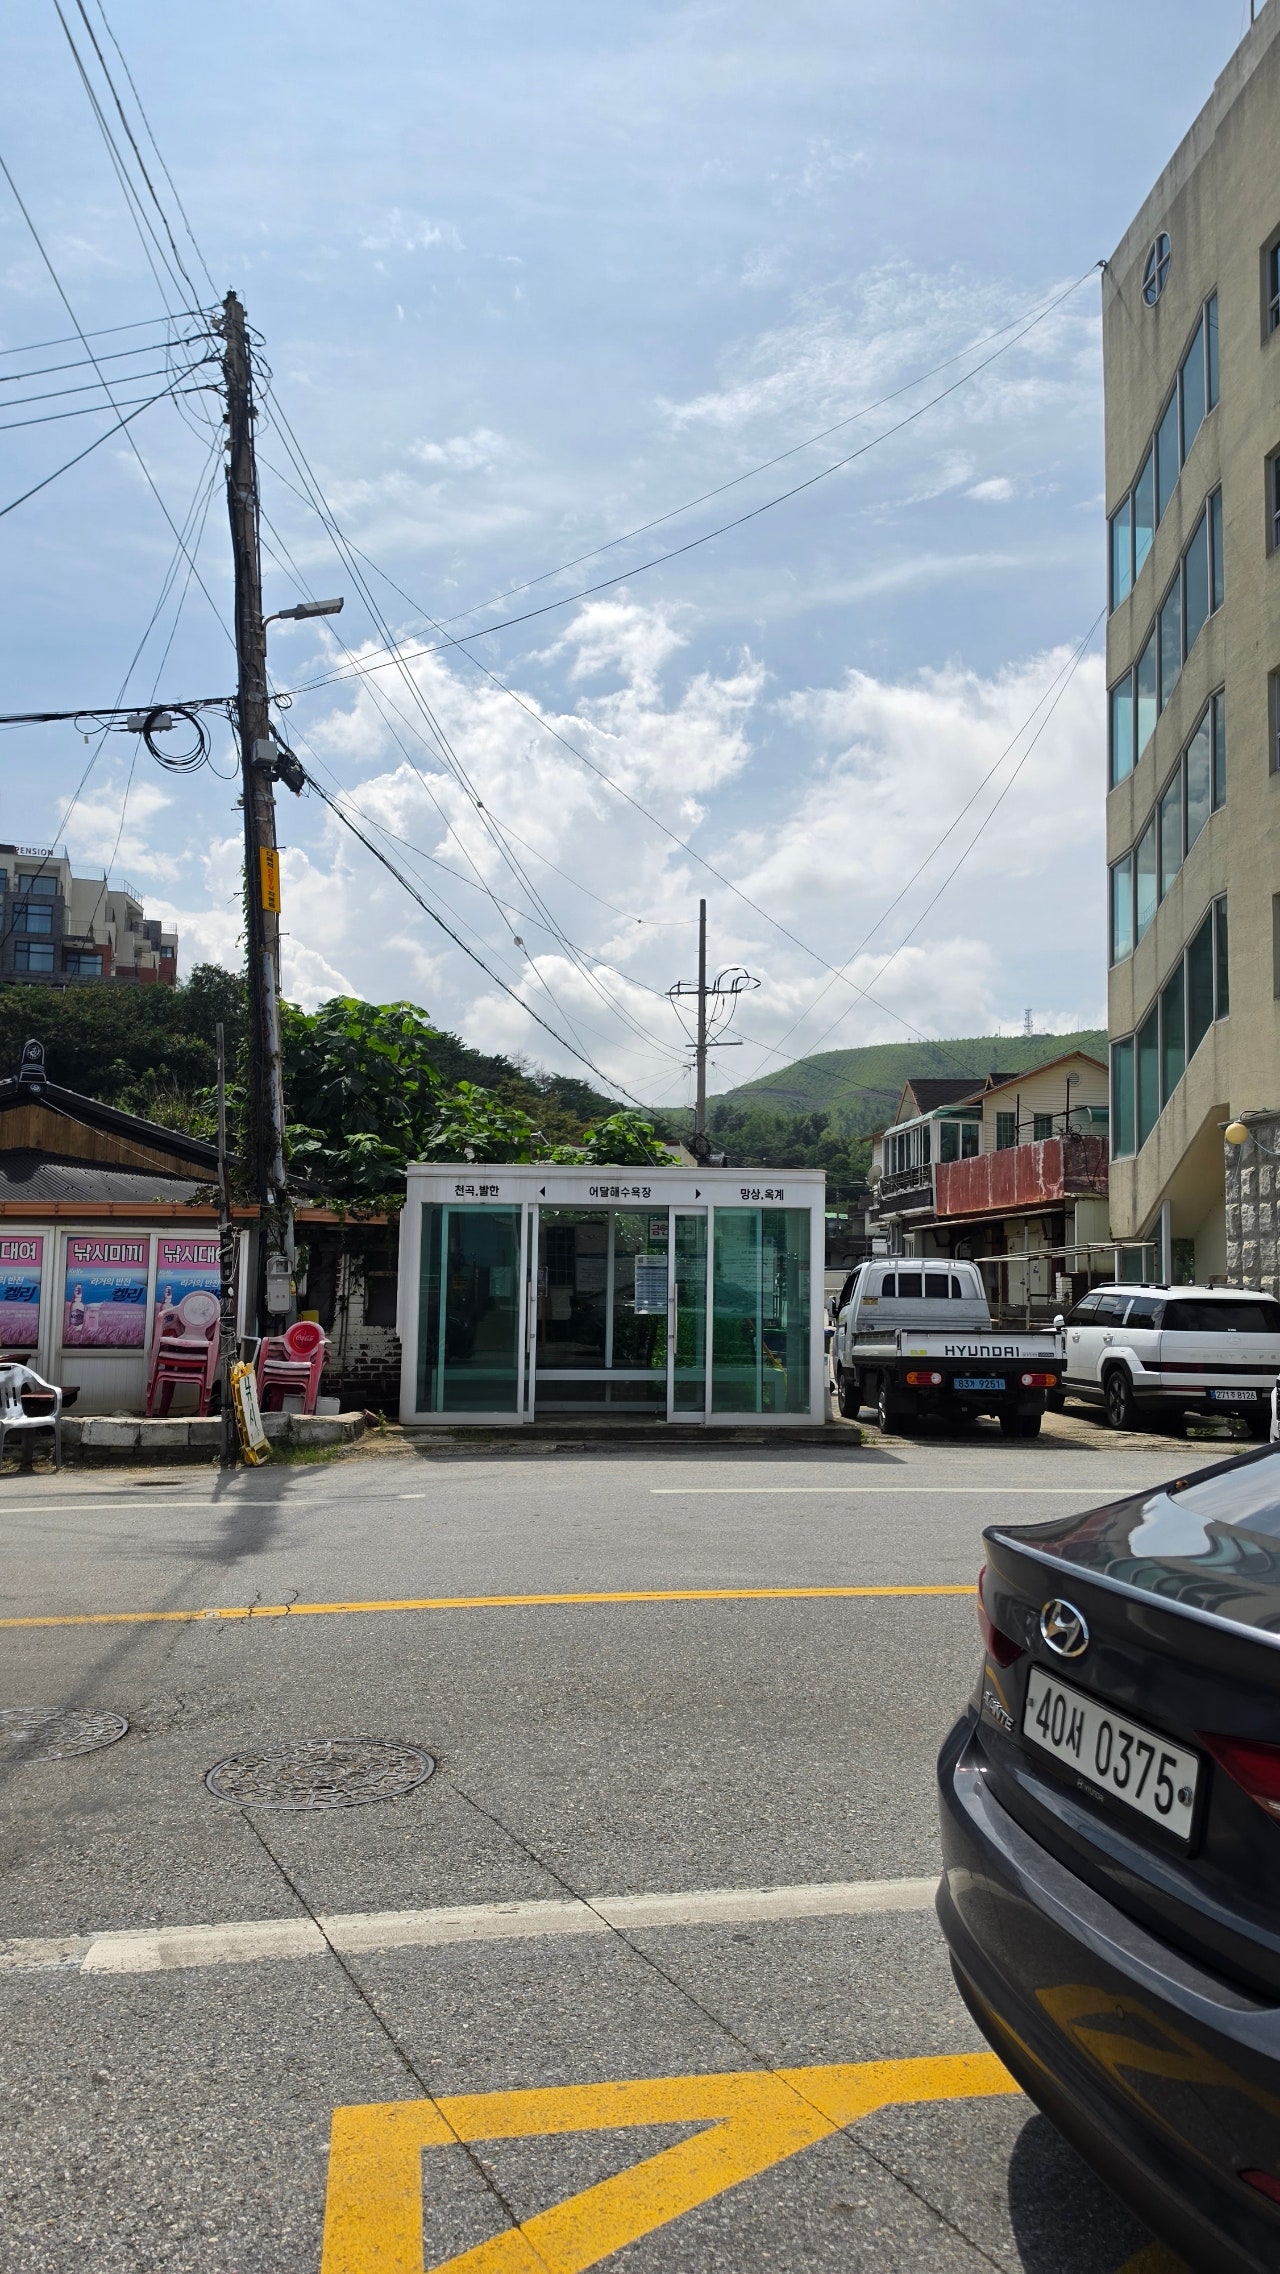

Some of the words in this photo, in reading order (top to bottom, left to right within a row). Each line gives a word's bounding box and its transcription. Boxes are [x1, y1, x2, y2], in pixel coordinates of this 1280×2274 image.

[454, 1185, 500, 1197] 천곡.발한
[589, 1186, 651, 1198] 어달해수욕장
[740, 1188, 784, 1201] 망상.옥계
[73, 1244, 144, 1262] 낚시미끼
[7, 1276, 25, 1285] 반전
[90, 1277, 114, 1286] 라거의
[115, 1277, 132, 1287] 반전
[180, 1279, 203, 1288] 라거의
[3, 1286, 37, 1302] 켈리
[111, 1287, 144, 1303] 켈리
[944, 1345, 1020, 1357] HYUNDAI
[979, 1379, 1002, 1389] 9251
[983, 1690, 1016, 1733] AVANTE
[1036, 1687, 1084, 1758] 40서
[1094, 1720, 1177, 1815] 0375
